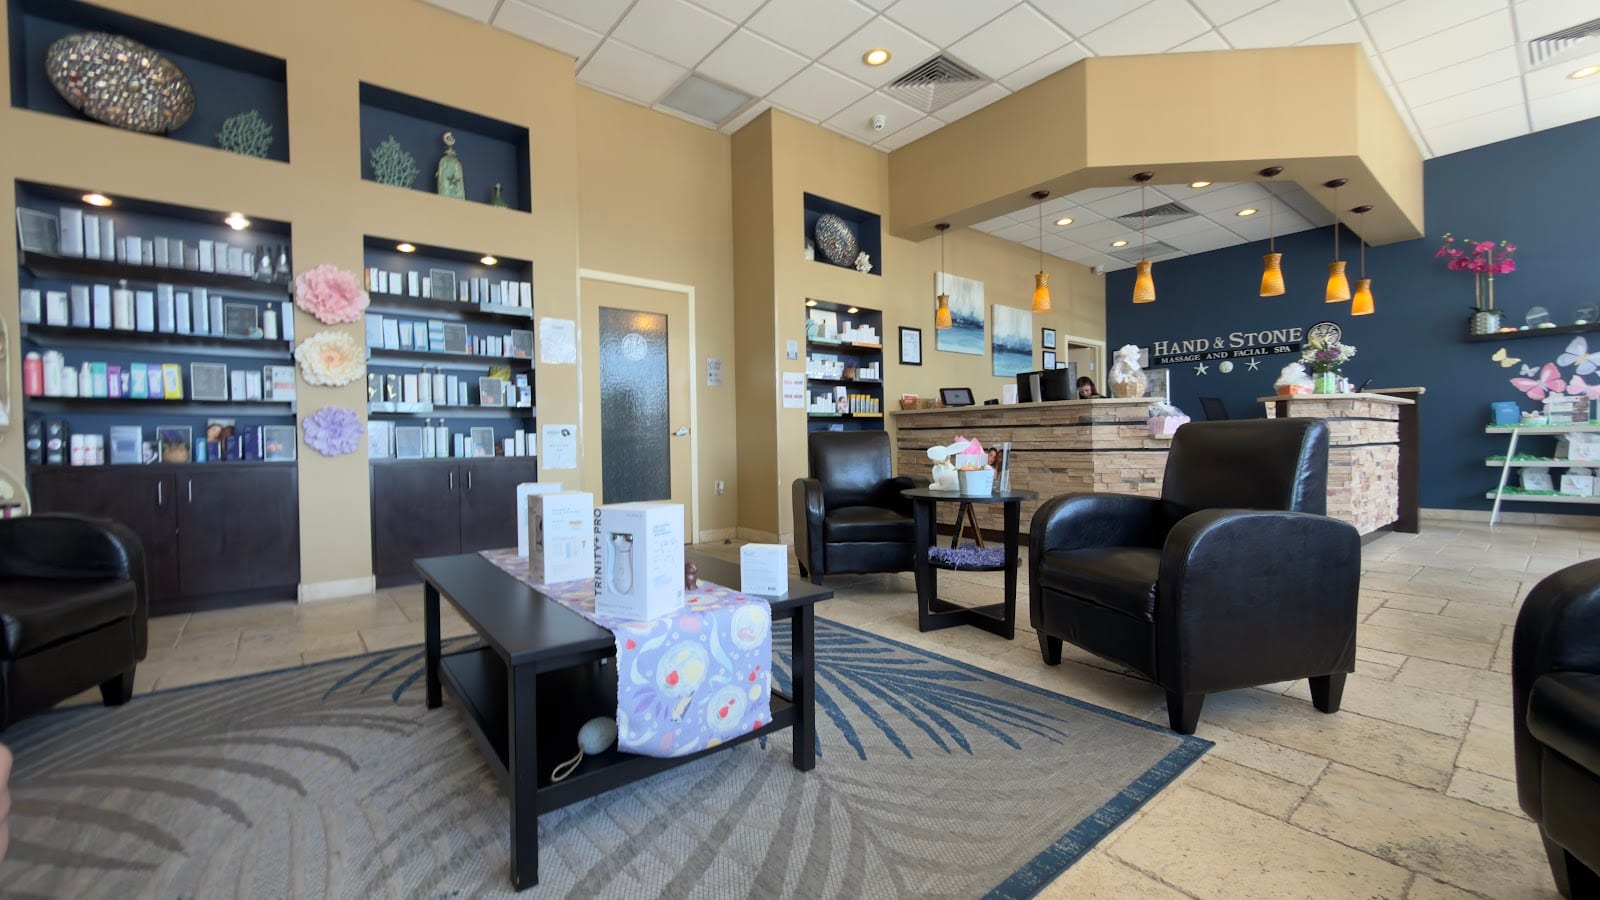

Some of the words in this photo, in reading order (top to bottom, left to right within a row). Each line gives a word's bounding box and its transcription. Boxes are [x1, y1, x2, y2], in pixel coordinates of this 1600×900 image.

[1154, 338, 1209, 356] HAND
[1213, 337, 1224, 349] &
[1229, 328, 1303, 348] STONE
[1161, 354, 1200, 364] MASSAGE
[1206, 351, 1228, 360] AND
[1233, 348, 1268, 357] FACIAL
[593, 508, 602, 596] TRINITY+PRO
